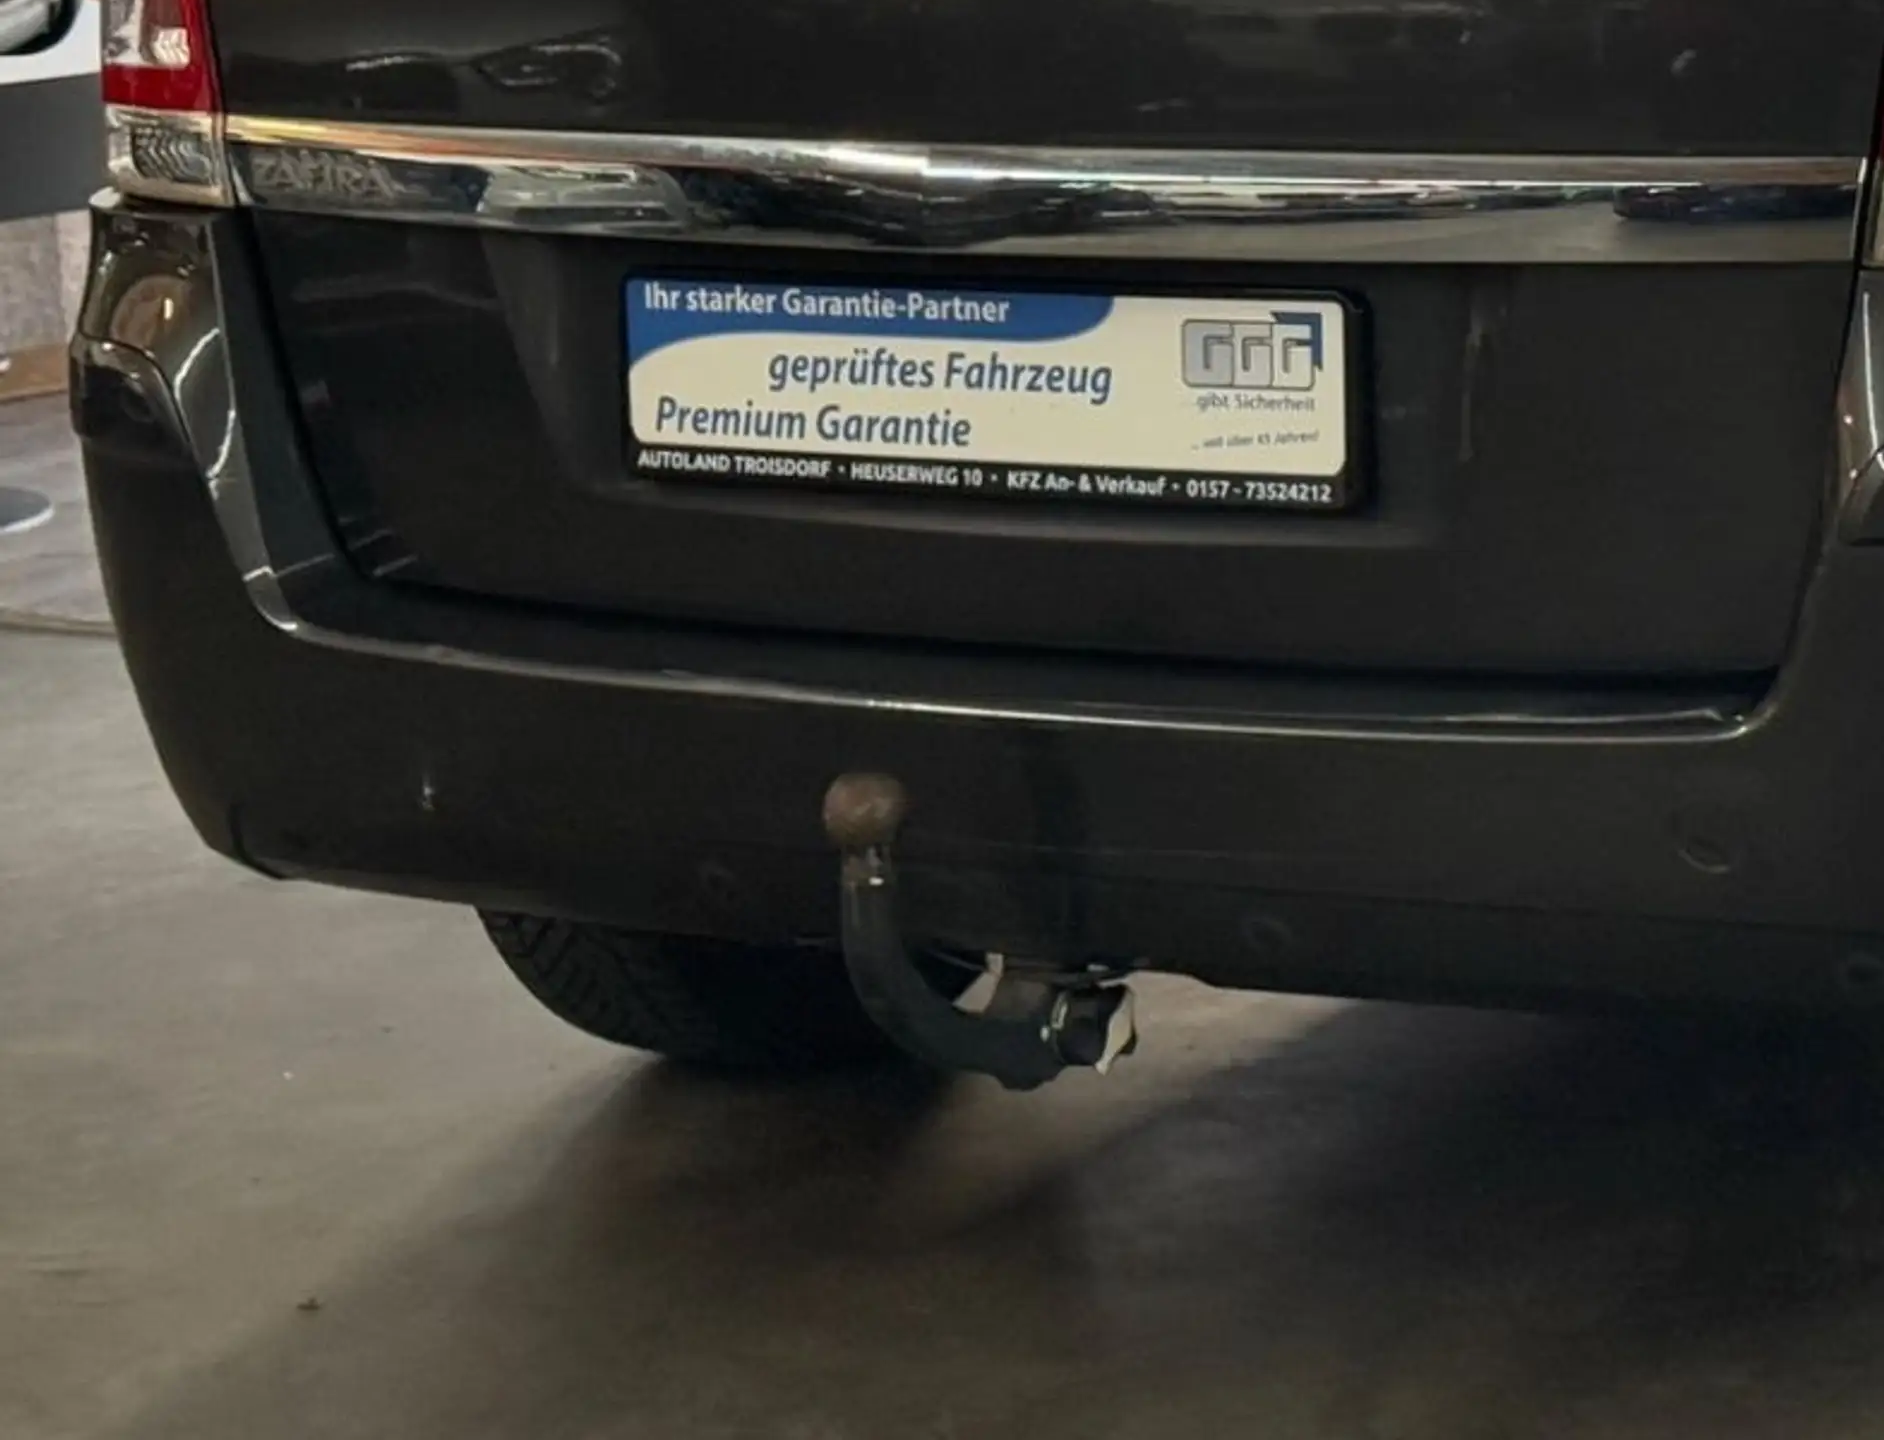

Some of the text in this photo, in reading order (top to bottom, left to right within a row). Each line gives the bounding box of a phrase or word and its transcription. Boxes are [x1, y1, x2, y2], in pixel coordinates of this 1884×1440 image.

[644, 282, 1010, 324] Ihr starker Garantie-Partner
[768, 350, 1113, 404] geprüftes Fahrzeug
[656, 397, 971, 448] Premium Garantie
[1234, 394, 1316, 413] Sicherheit
[638, 450, 731, 474] AUTOLAND
[734, 455, 832, 479] TROISDORF
[850, 461, 959, 487] HEUSERWEG
[963, 467, 984, 488] 10
[1007, 470, 1041, 491] KFZ
[1079, 474, 1093, 493] &
[1096, 475, 1167, 497] Verkauf
